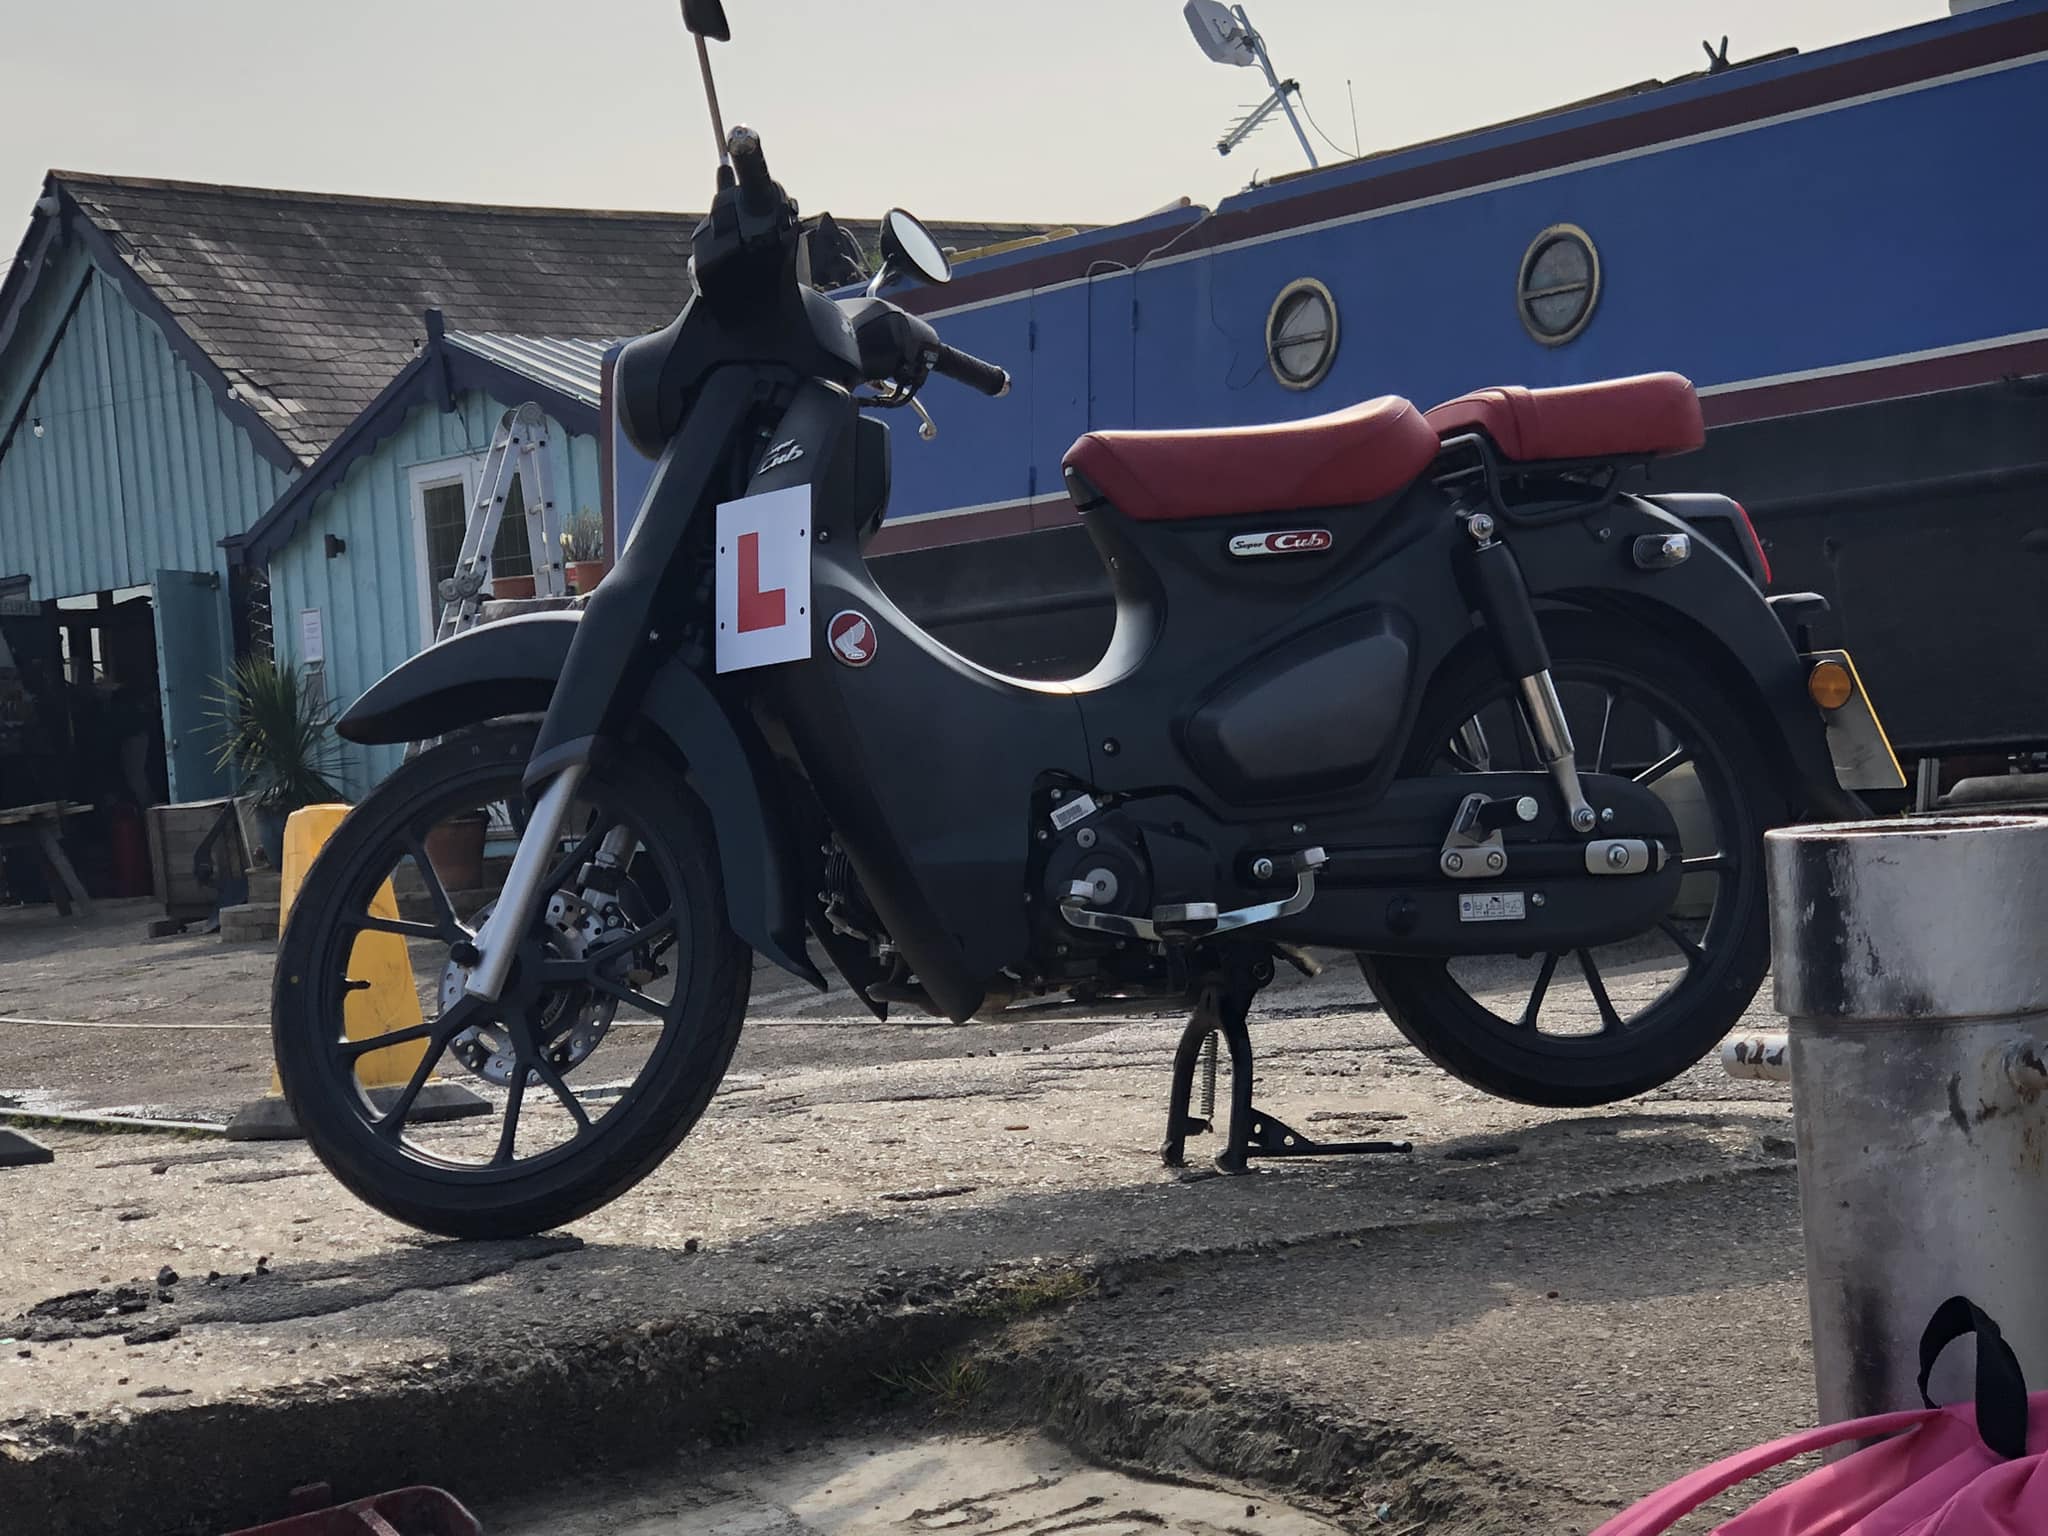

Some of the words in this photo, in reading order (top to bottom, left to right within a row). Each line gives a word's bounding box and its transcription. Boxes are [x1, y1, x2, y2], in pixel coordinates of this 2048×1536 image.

[1233, 540, 1264, 550] Super
[1274, 533, 1325, 549] Cub
[737, 531, 786, 634] L
